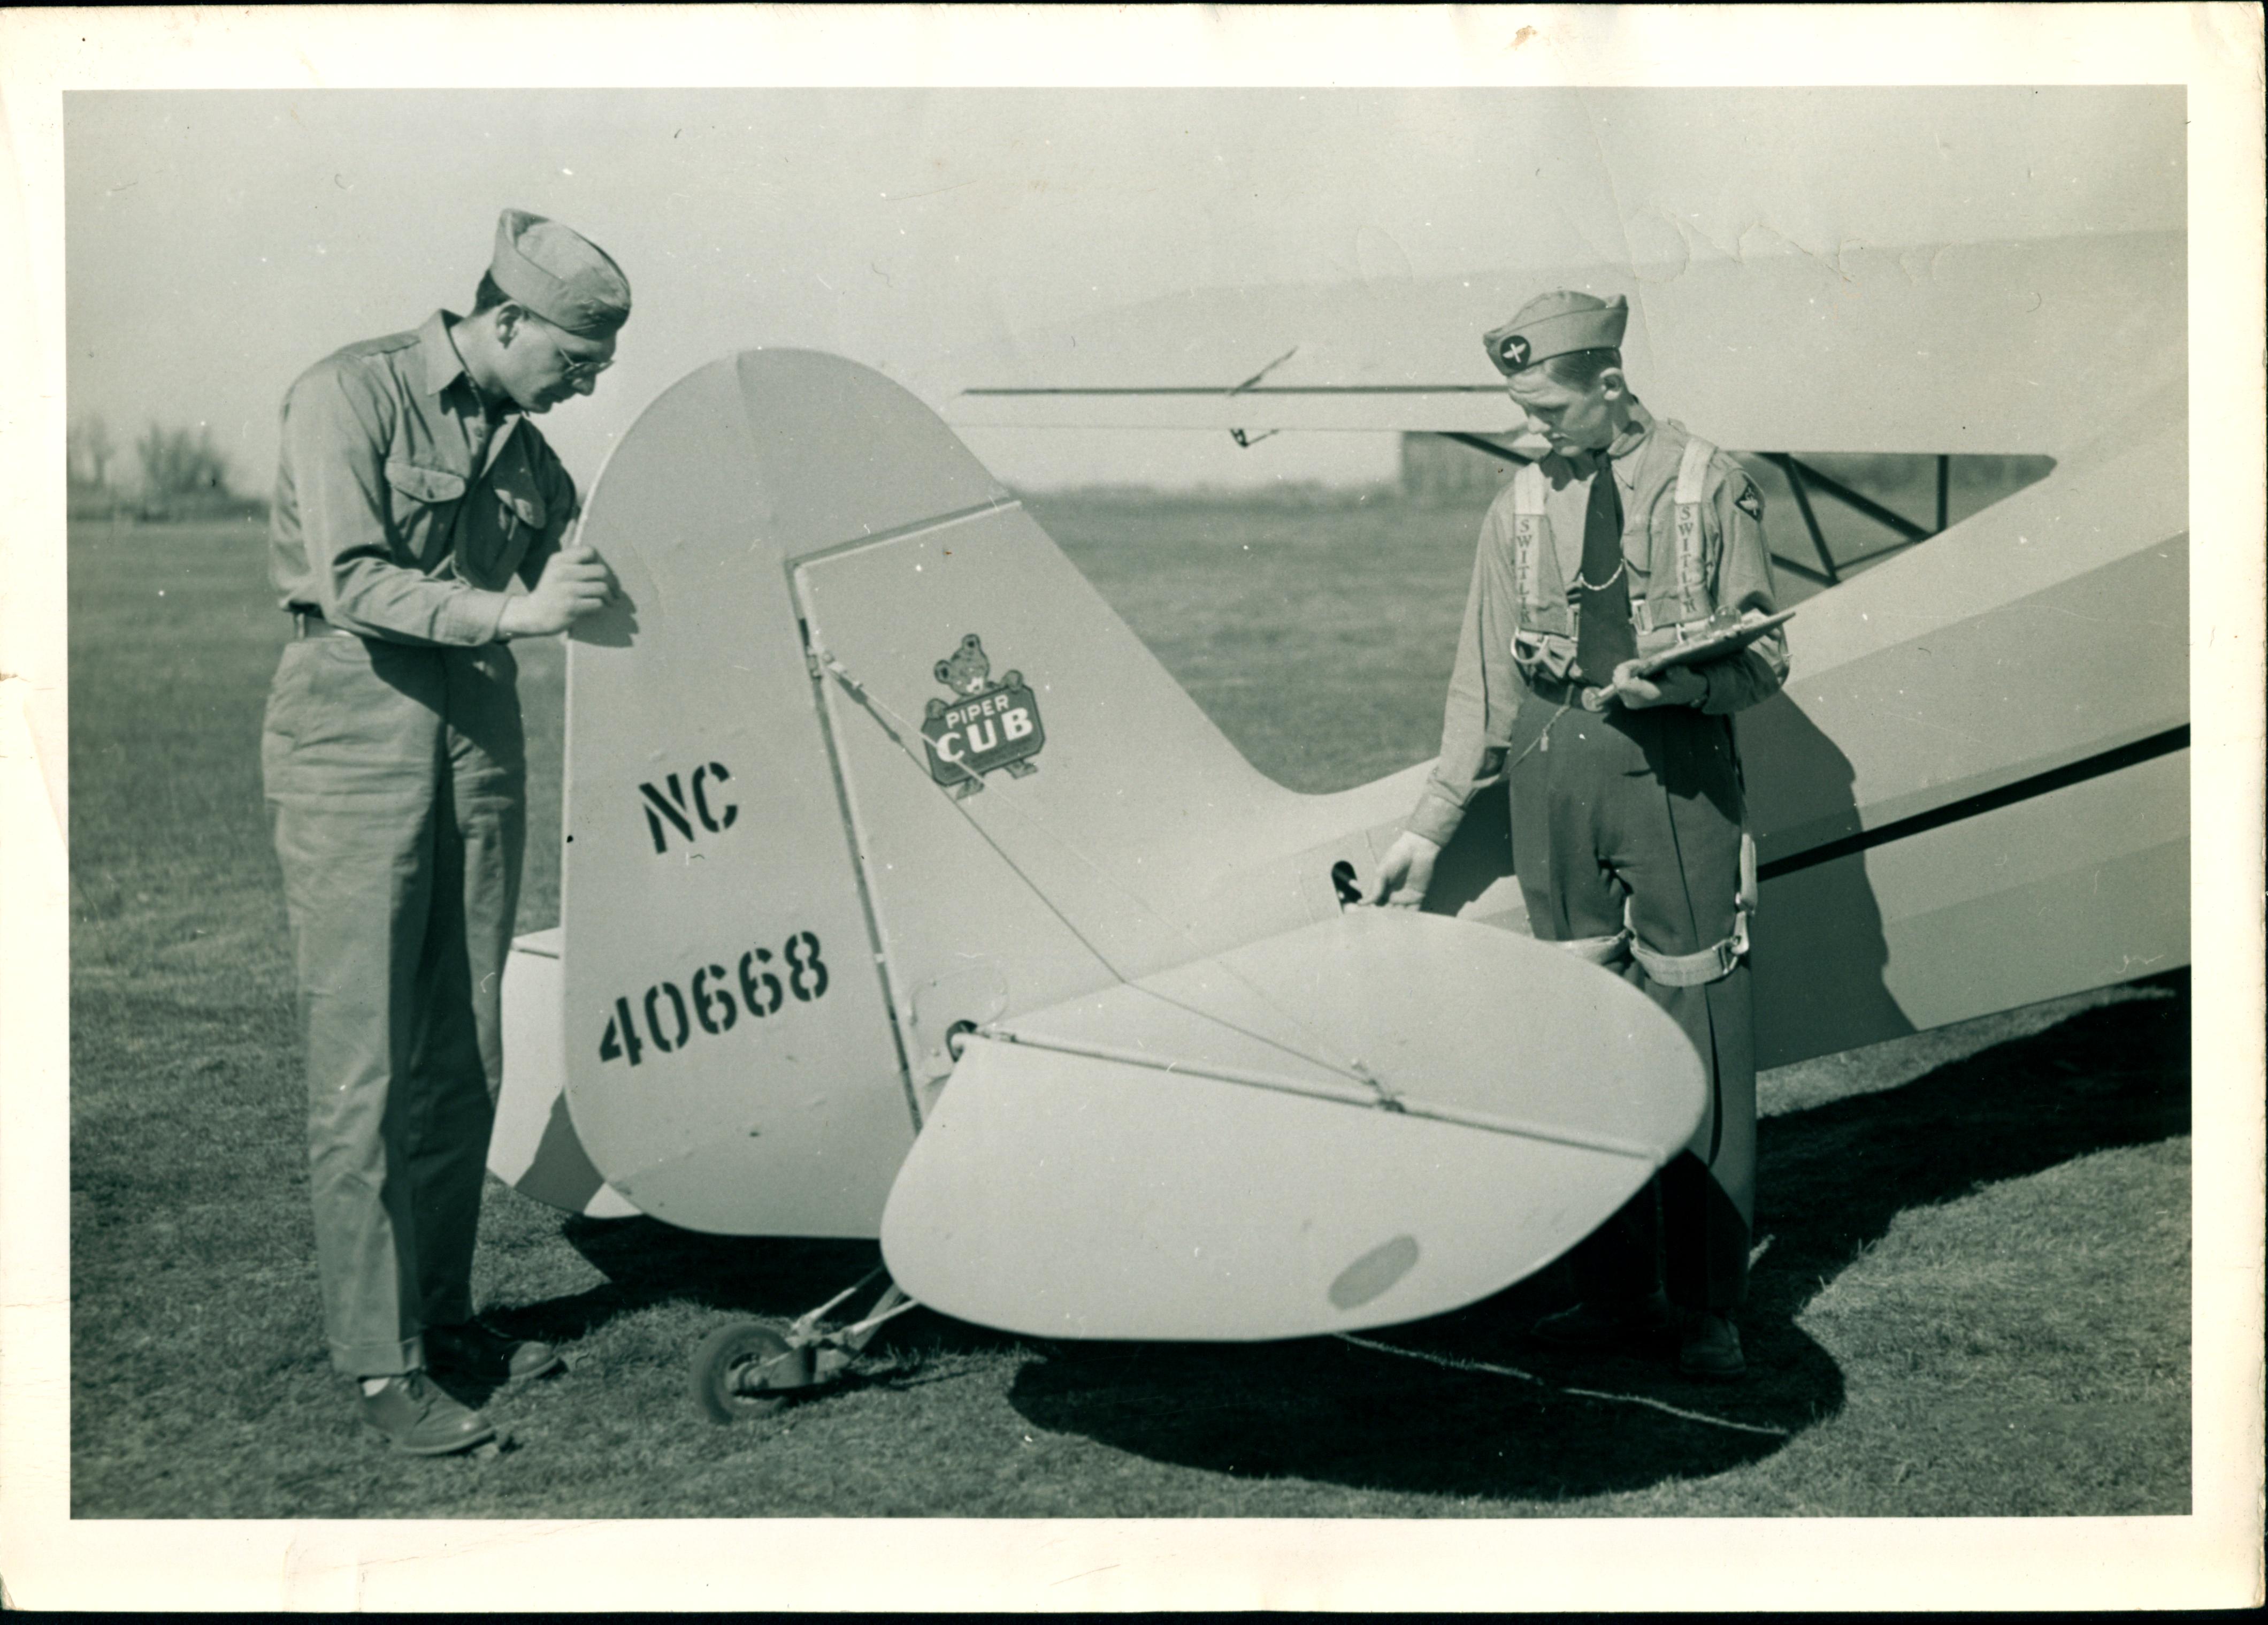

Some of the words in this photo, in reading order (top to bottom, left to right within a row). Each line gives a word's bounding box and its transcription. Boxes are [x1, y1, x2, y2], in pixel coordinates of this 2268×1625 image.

[936, 707, 1033, 762] CUB
[945, 694, 1010, 729] PIPER
[638, 761, 738, 855] NC
[598, 930, 829, 1067] 40668
